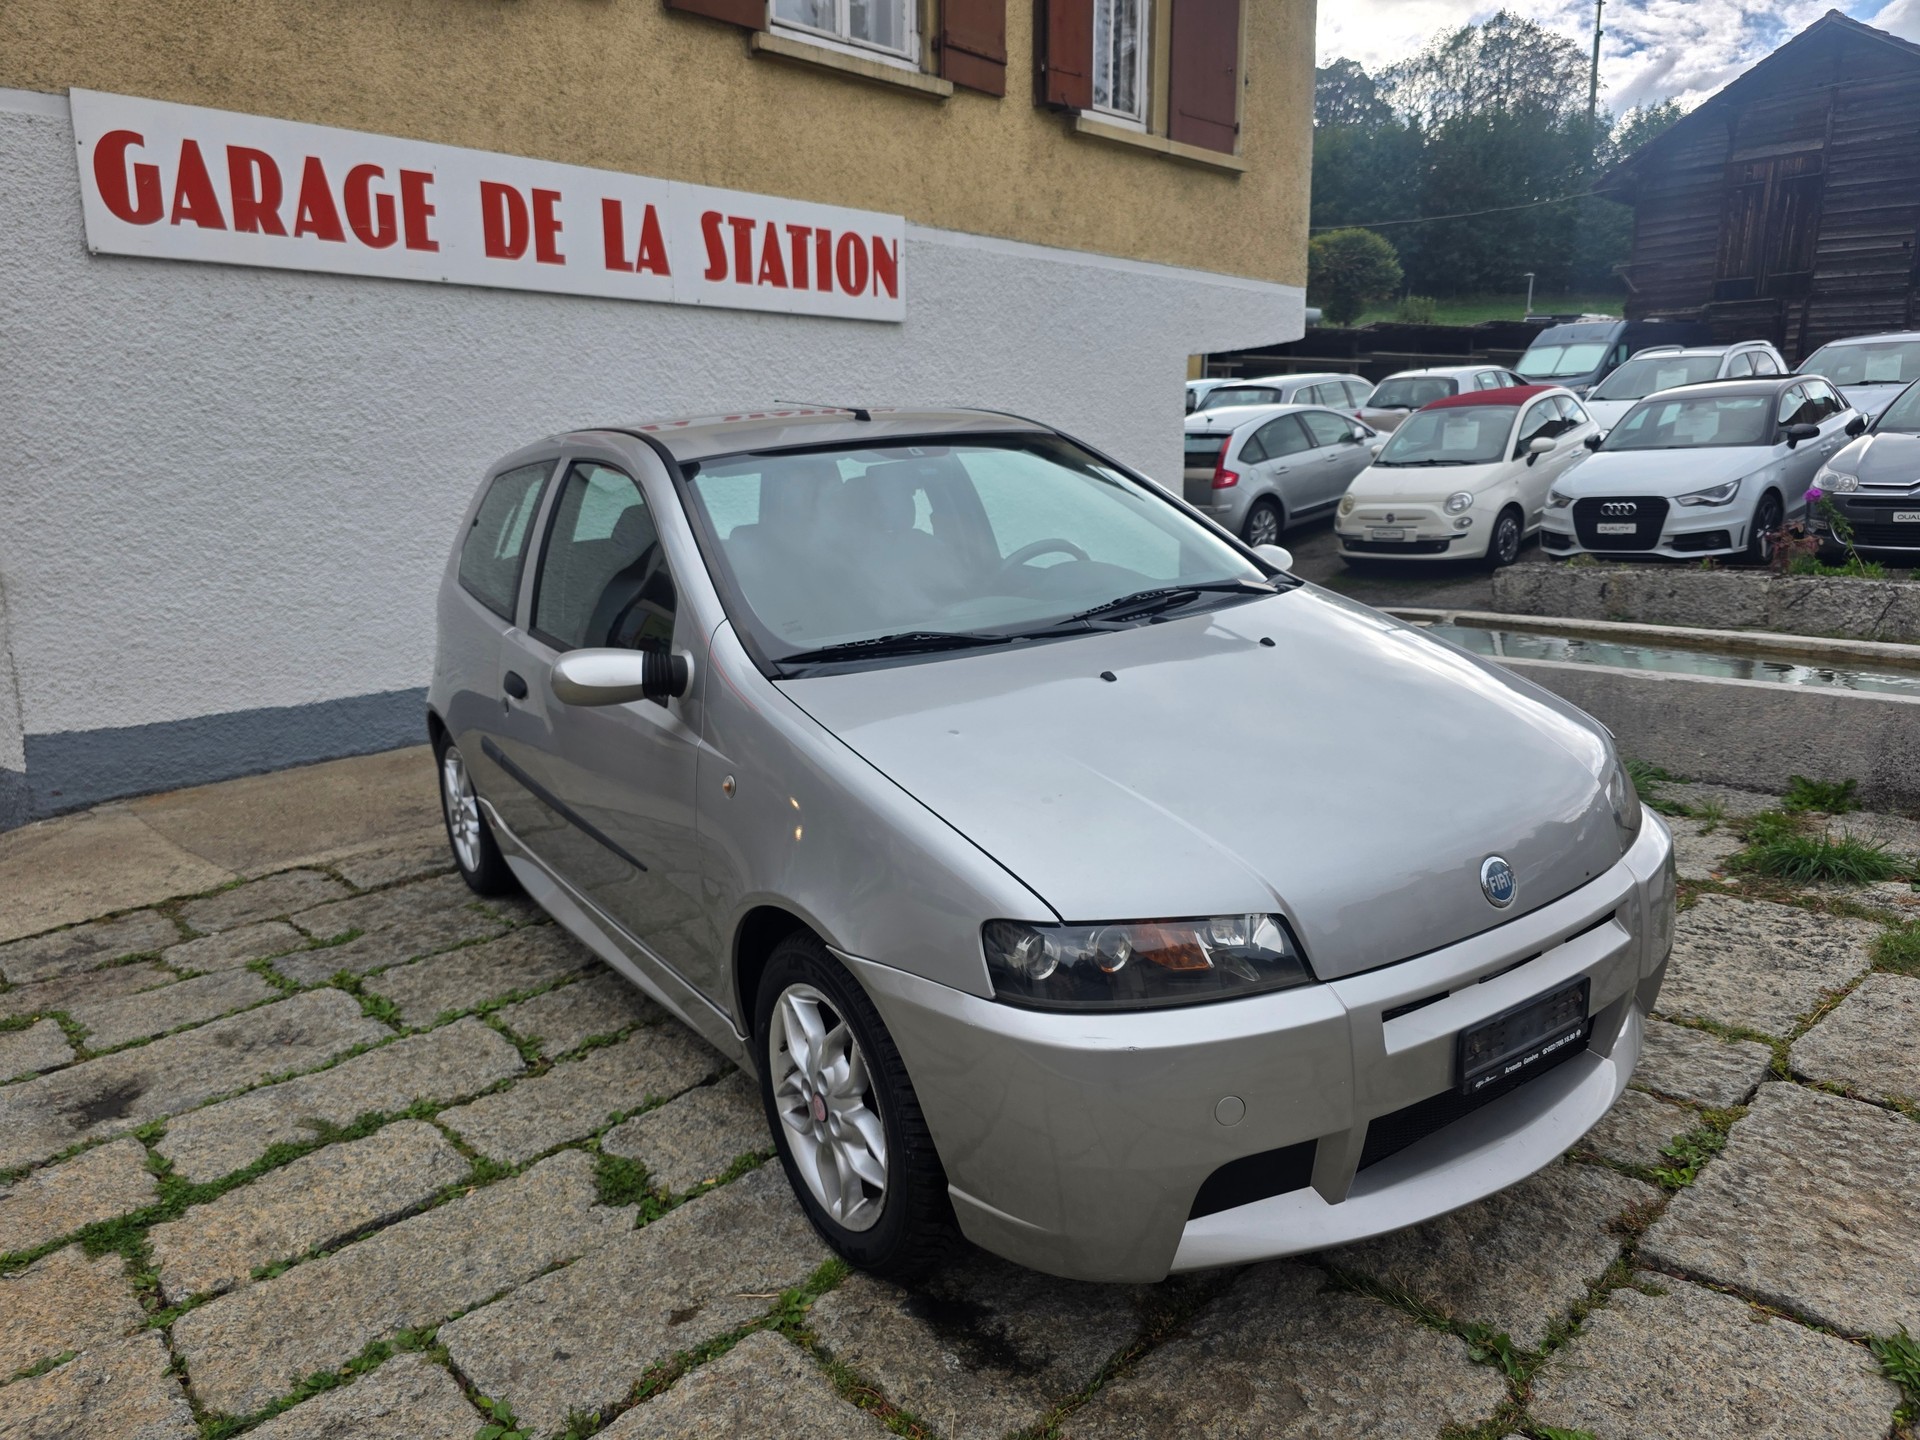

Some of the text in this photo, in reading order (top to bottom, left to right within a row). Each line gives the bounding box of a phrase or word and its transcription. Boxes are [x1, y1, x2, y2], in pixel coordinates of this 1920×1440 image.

[93, 129, 899, 299] GARAGE DE LA STATION
[1488, 870, 1512, 893] FIAT
